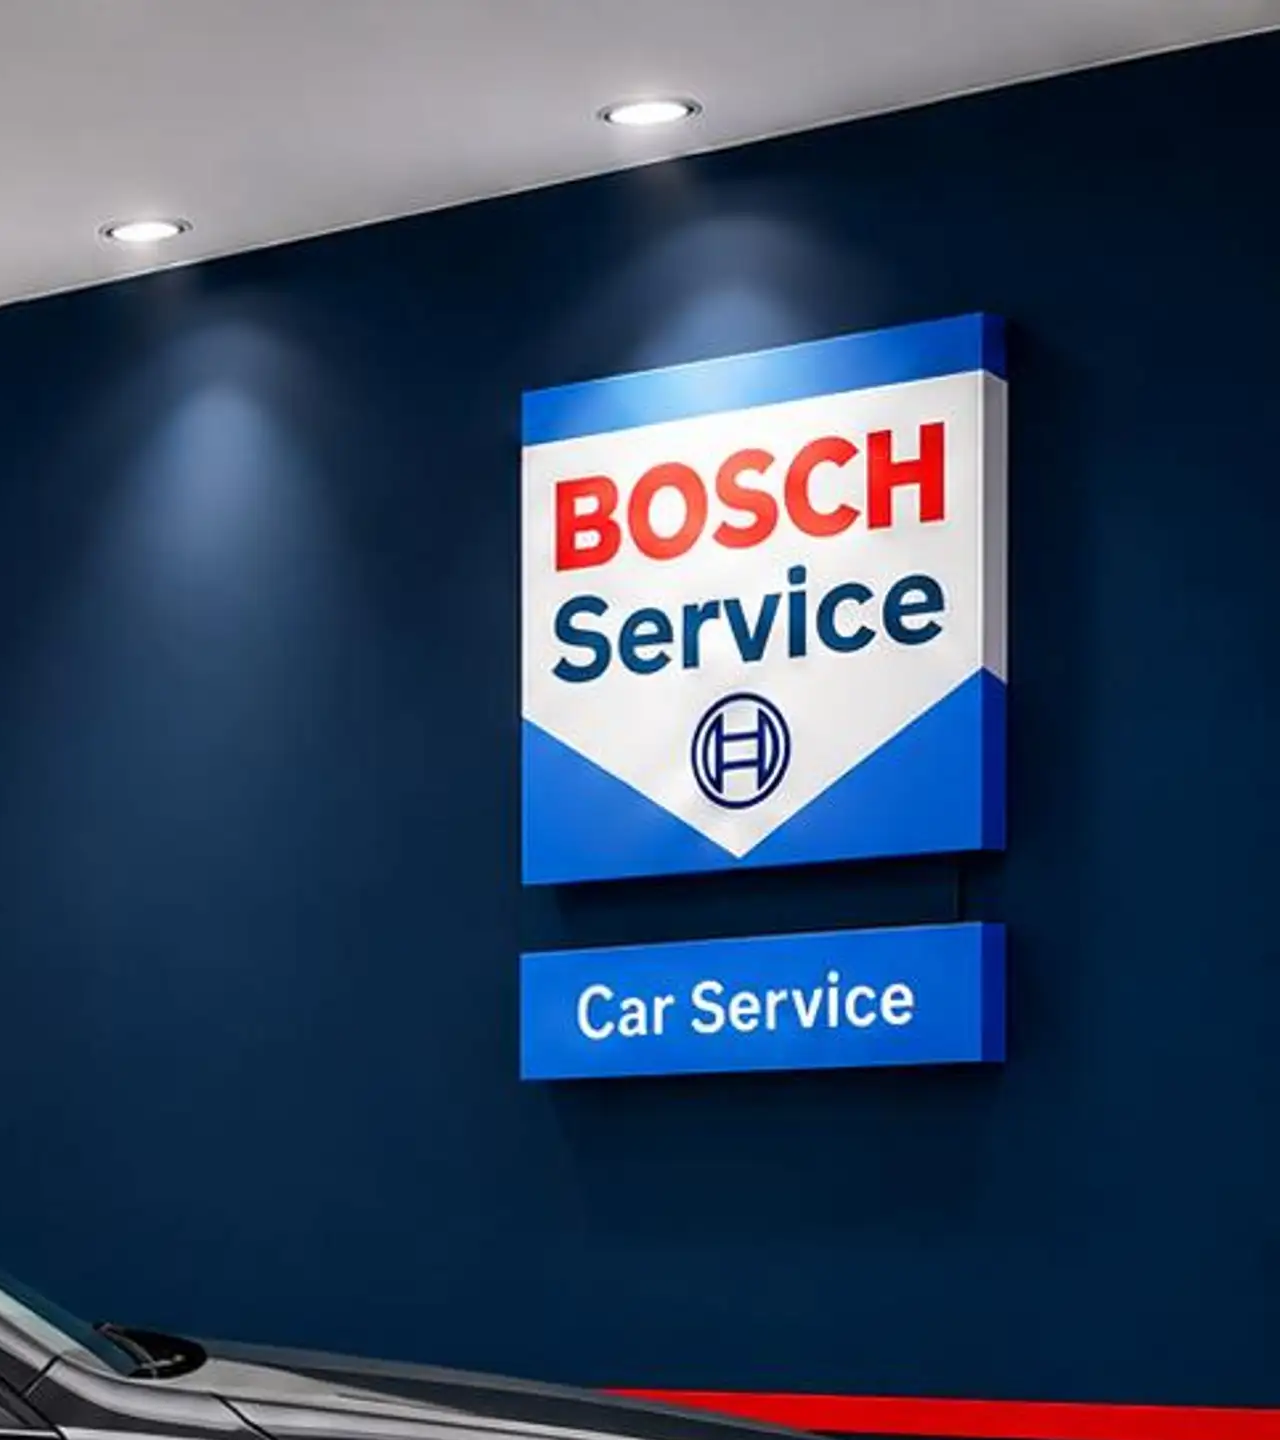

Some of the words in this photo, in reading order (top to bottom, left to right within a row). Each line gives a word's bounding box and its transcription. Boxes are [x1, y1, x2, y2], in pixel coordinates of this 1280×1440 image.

[554, 421, 945, 572] BOSCH
[552, 565, 945, 683] Service
[577, 984, 674, 1040] Car
[691, 971, 916, 1034] Service
